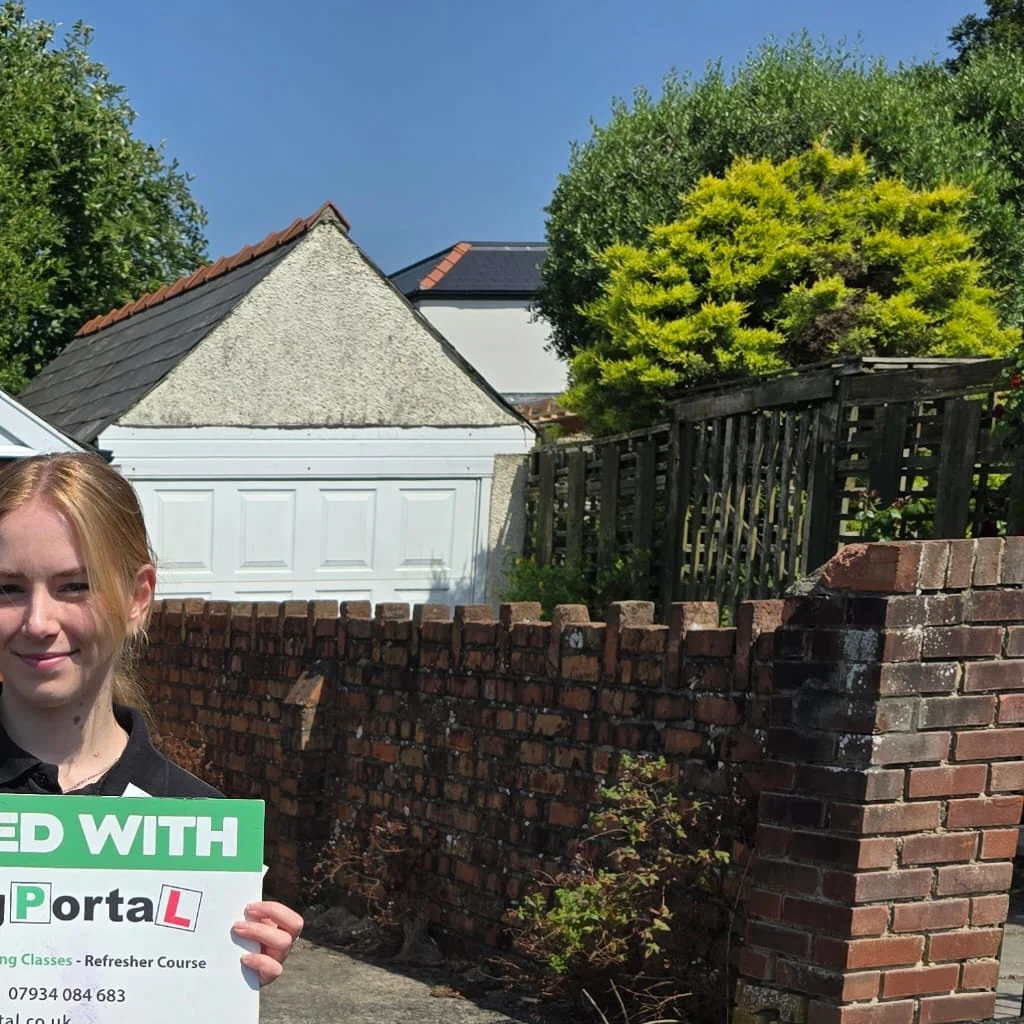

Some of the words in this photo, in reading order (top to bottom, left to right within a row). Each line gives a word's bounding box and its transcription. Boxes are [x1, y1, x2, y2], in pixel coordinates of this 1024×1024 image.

[78, 813, 238, 857] WITH
[21, 953, 73, 967] Classes
[84, 954, 153, 968] Refresher
[157, 956, 207, 969] Course
[8, 986, 58, 1001] 07934
[62, 988, 92, 1002] 084
[96, 988, 126, 1003] 683
